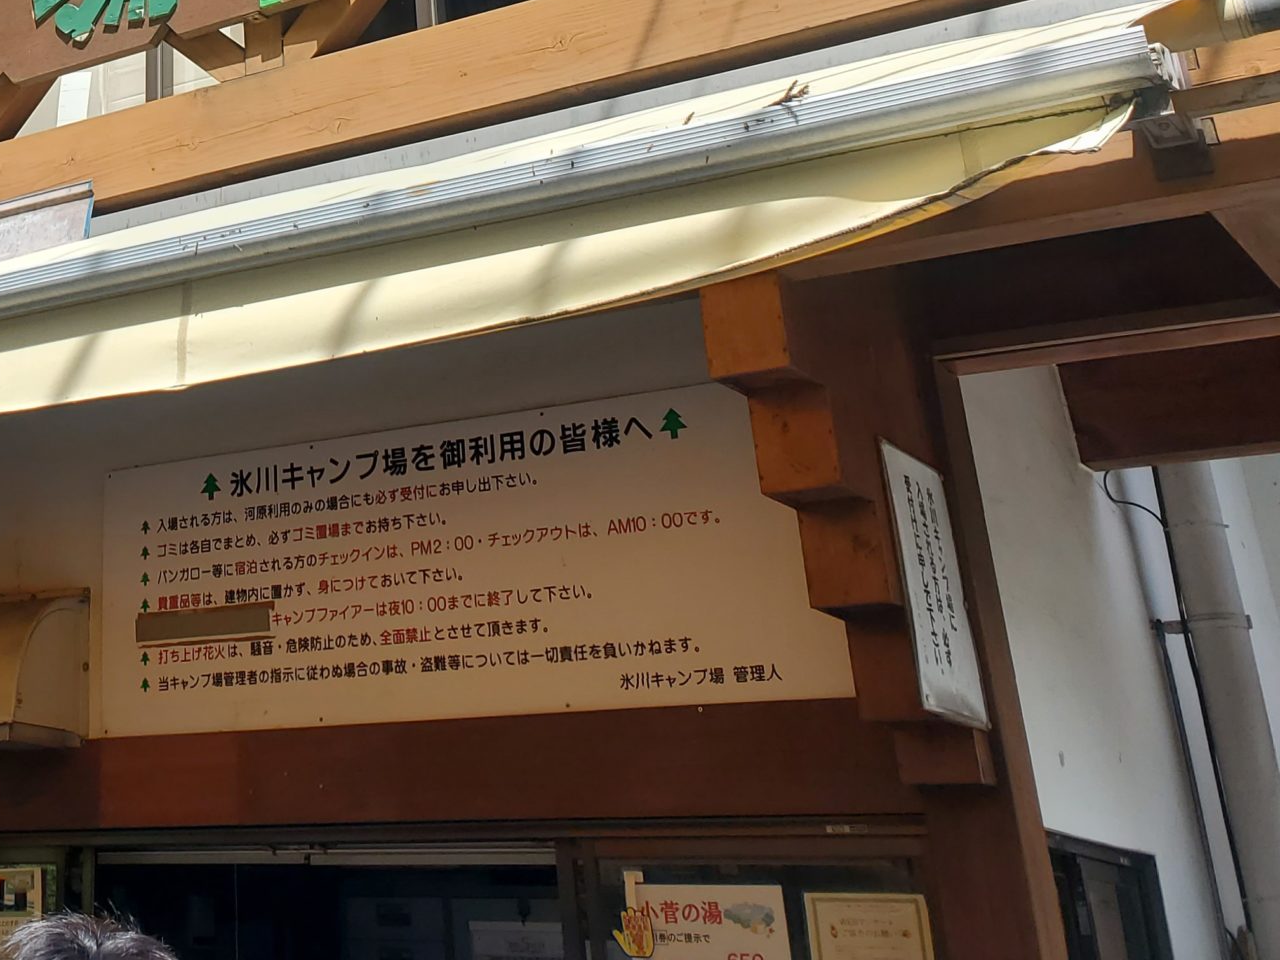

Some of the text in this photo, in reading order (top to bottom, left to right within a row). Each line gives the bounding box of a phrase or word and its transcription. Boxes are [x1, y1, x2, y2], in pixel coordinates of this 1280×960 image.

[230, 416, 653, 497] 氷川キャンプ場を御利用の皆様へ
[157, 472, 537, 533] 入場される方は、河原利用のみの場合にも必ず受付にお申し出下さい。
[157, 512, 447, 558] ゴミは各自でまとめ、必ずゴミ置場までお持ち下さい。
[158, 568, 463, 611] 貴重品等は、建物内に置かず、身につけておいて下さい。
[158, 618, 548, 664] 打ち上げ花火は、騒音・危険防止のため、全面禁止とさせて頂きます。
[158, 637, 700, 691] 当キャンプ場管理者の指示に従わぬ場合の事故・盗難等については一切責任を負いかねます。
[620, 665, 782, 690] 氷川キャンプ場 管理人
[641, 900, 723, 925] 小菅の湯
[654, 931, 711, 944] 券のご提示で
